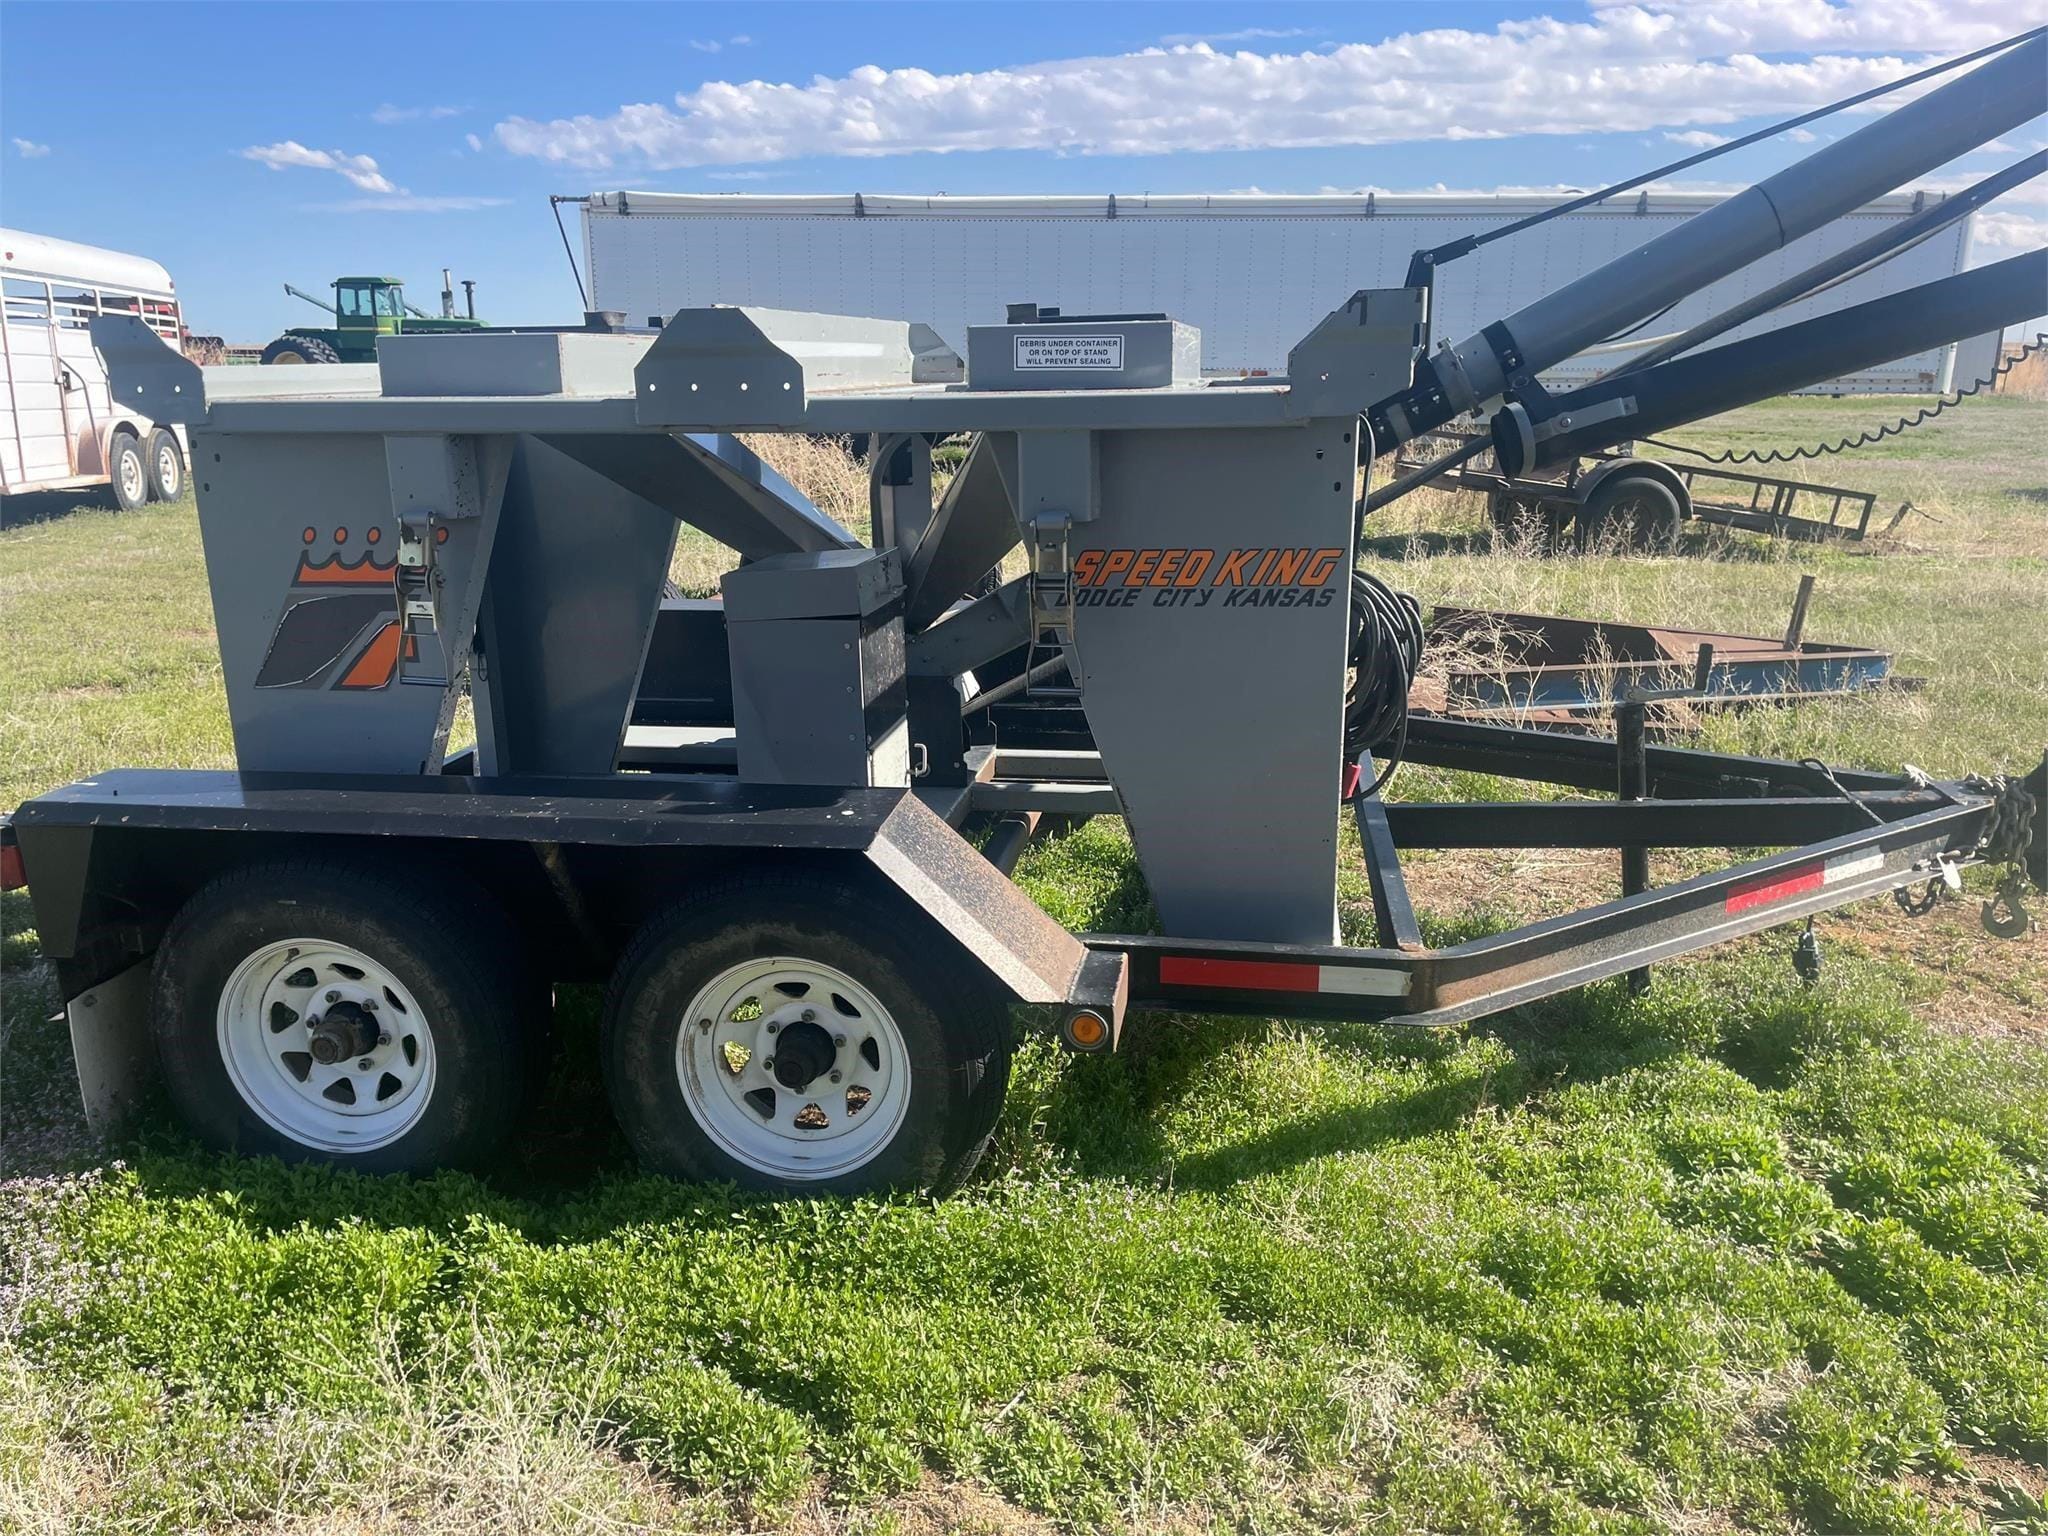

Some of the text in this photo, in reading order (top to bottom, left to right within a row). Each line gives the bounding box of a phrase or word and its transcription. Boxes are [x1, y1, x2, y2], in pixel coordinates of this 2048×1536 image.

[1019, 340, 1046, 348] DEBRIS
[1073, 548, 1345, 587] SPEED KING
[1153, 588, 1213, 607] CITY
[1223, 588, 1336, 607] KANSAS
